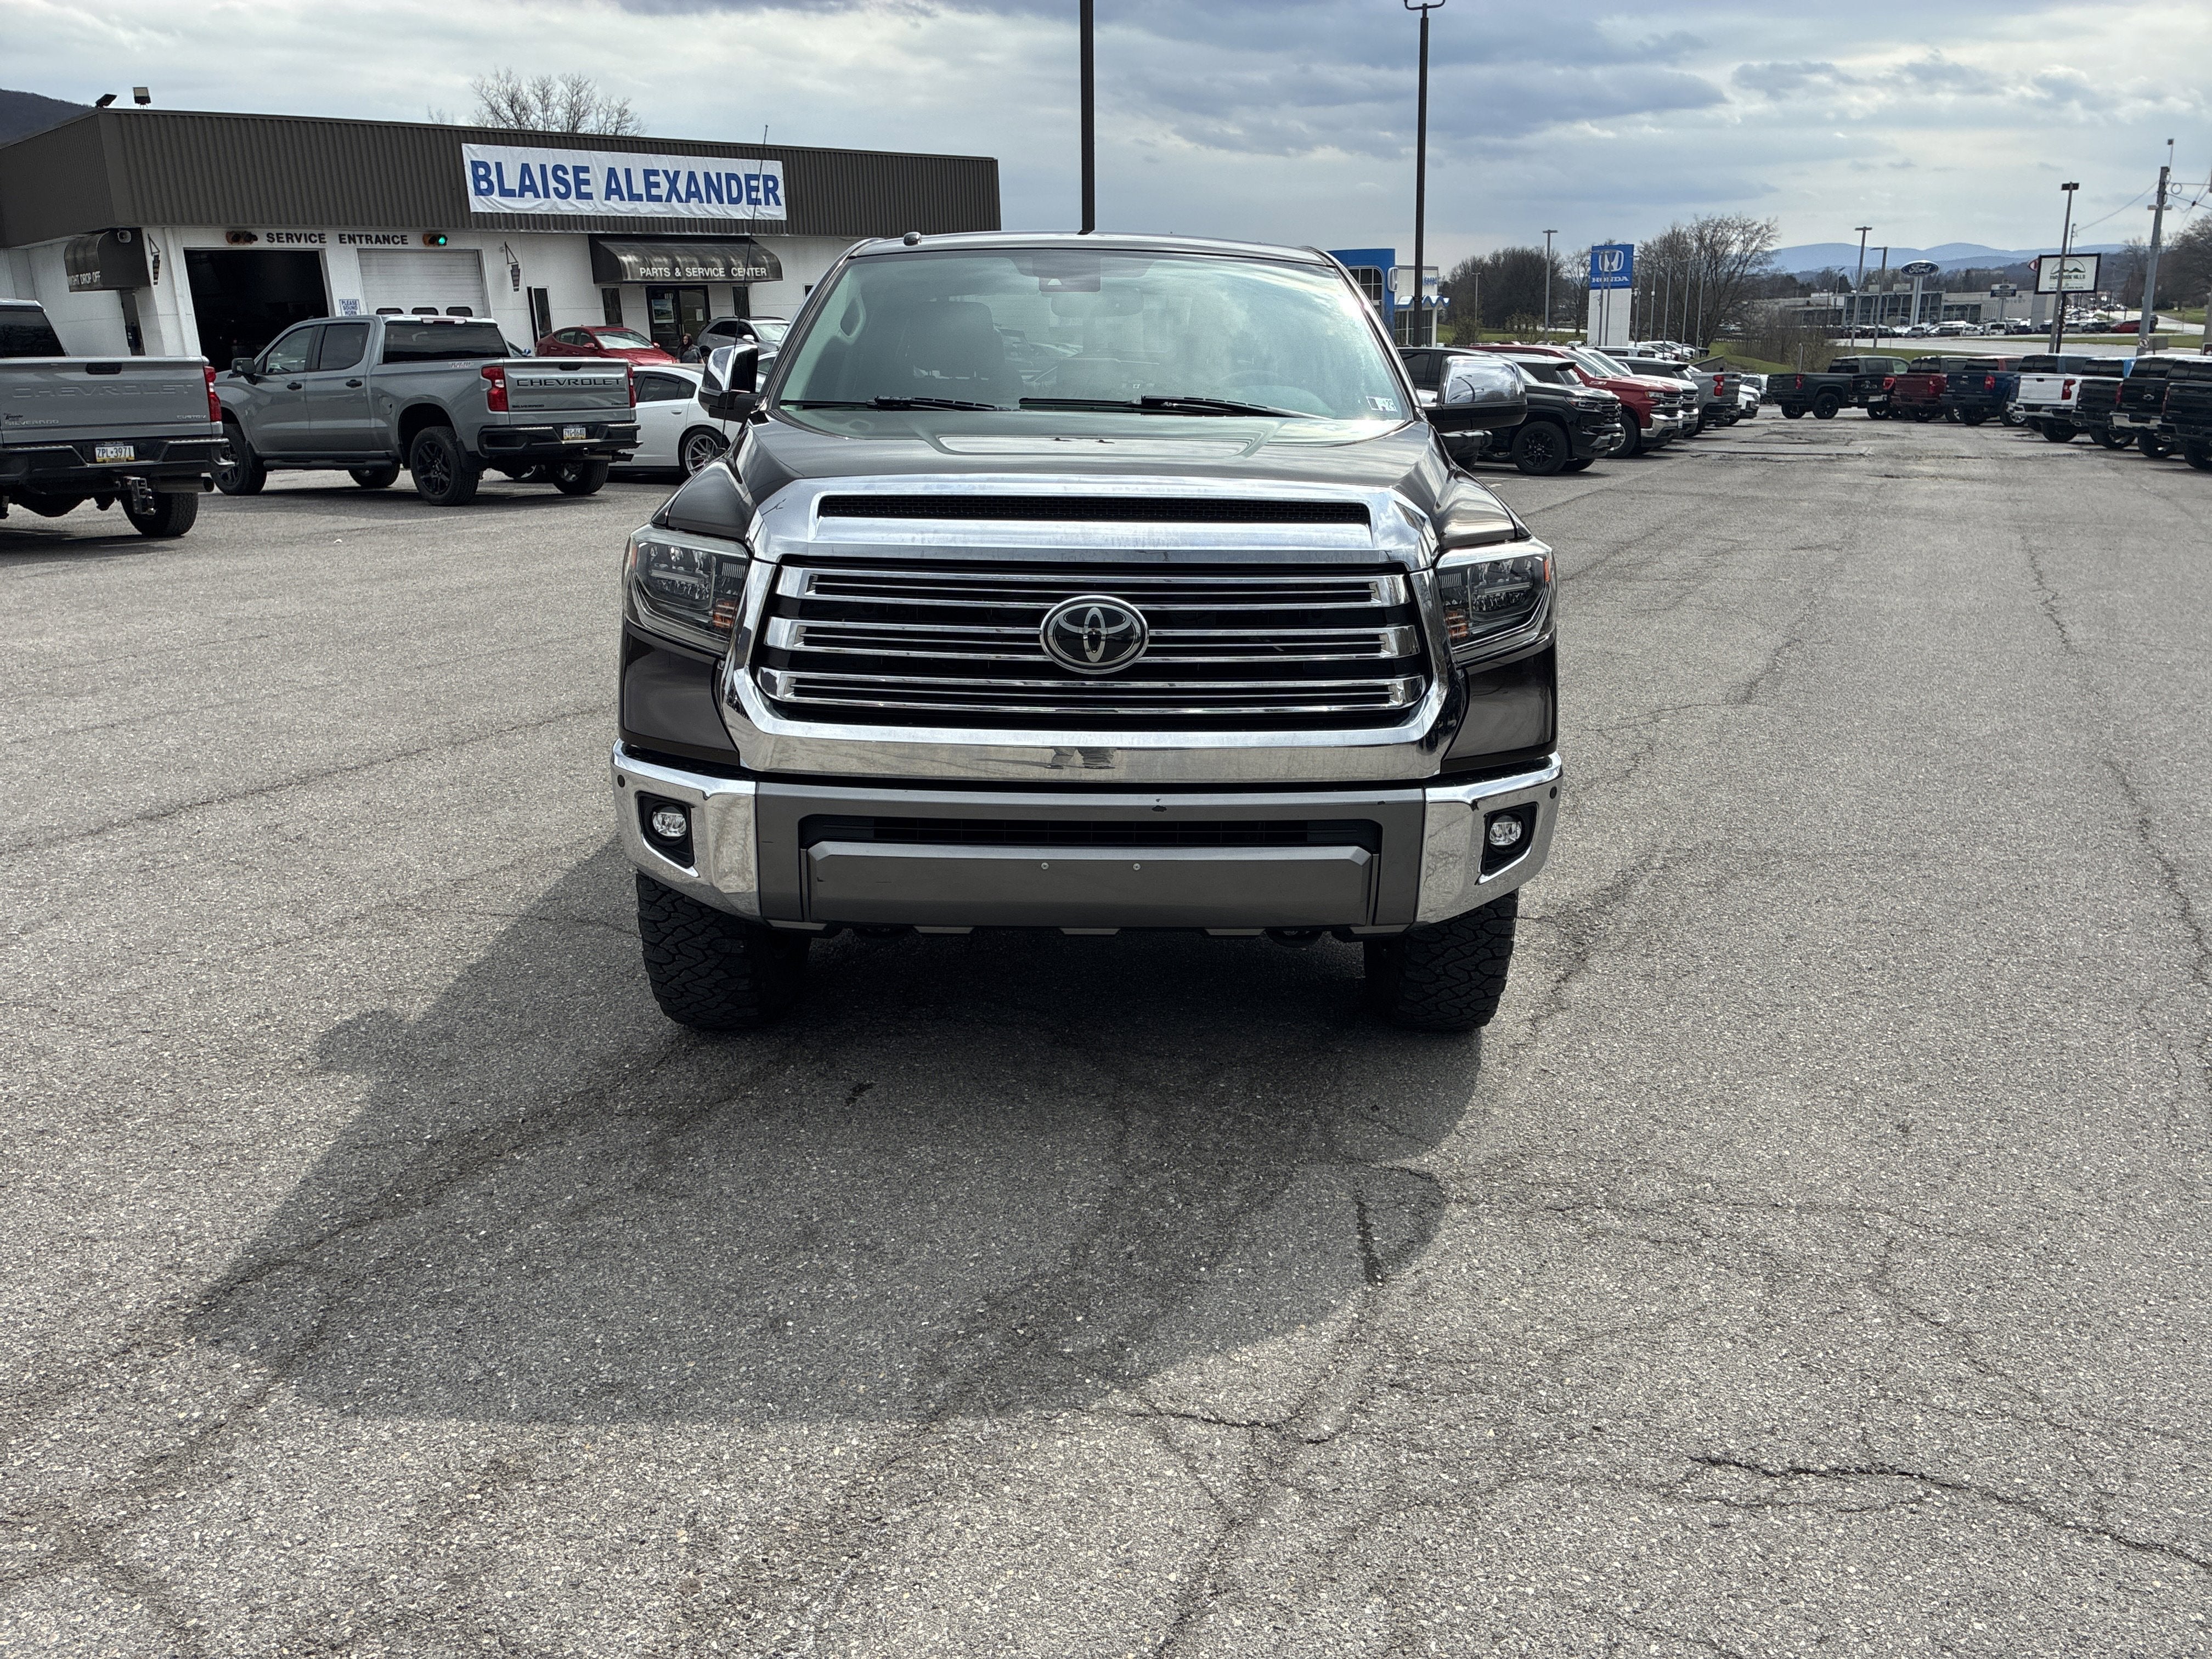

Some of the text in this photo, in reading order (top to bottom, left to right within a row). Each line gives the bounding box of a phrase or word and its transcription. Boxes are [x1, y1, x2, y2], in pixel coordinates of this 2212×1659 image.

[470, 160, 782, 206] BLAISE ALEXANDER
[266, 232, 409, 245] SERVICE ENTRANCE
[639, 267, 767, 277] PARTS & SERVICE CENTER
[1909, 264, 1931, 273] Ford
[80, 272, 92, 285] DROP
[92, 270, 101, 283] OFF
[516, 378, 623, 387] CHEVROLET
[12, 384, 194, 398] CHEVROLET
